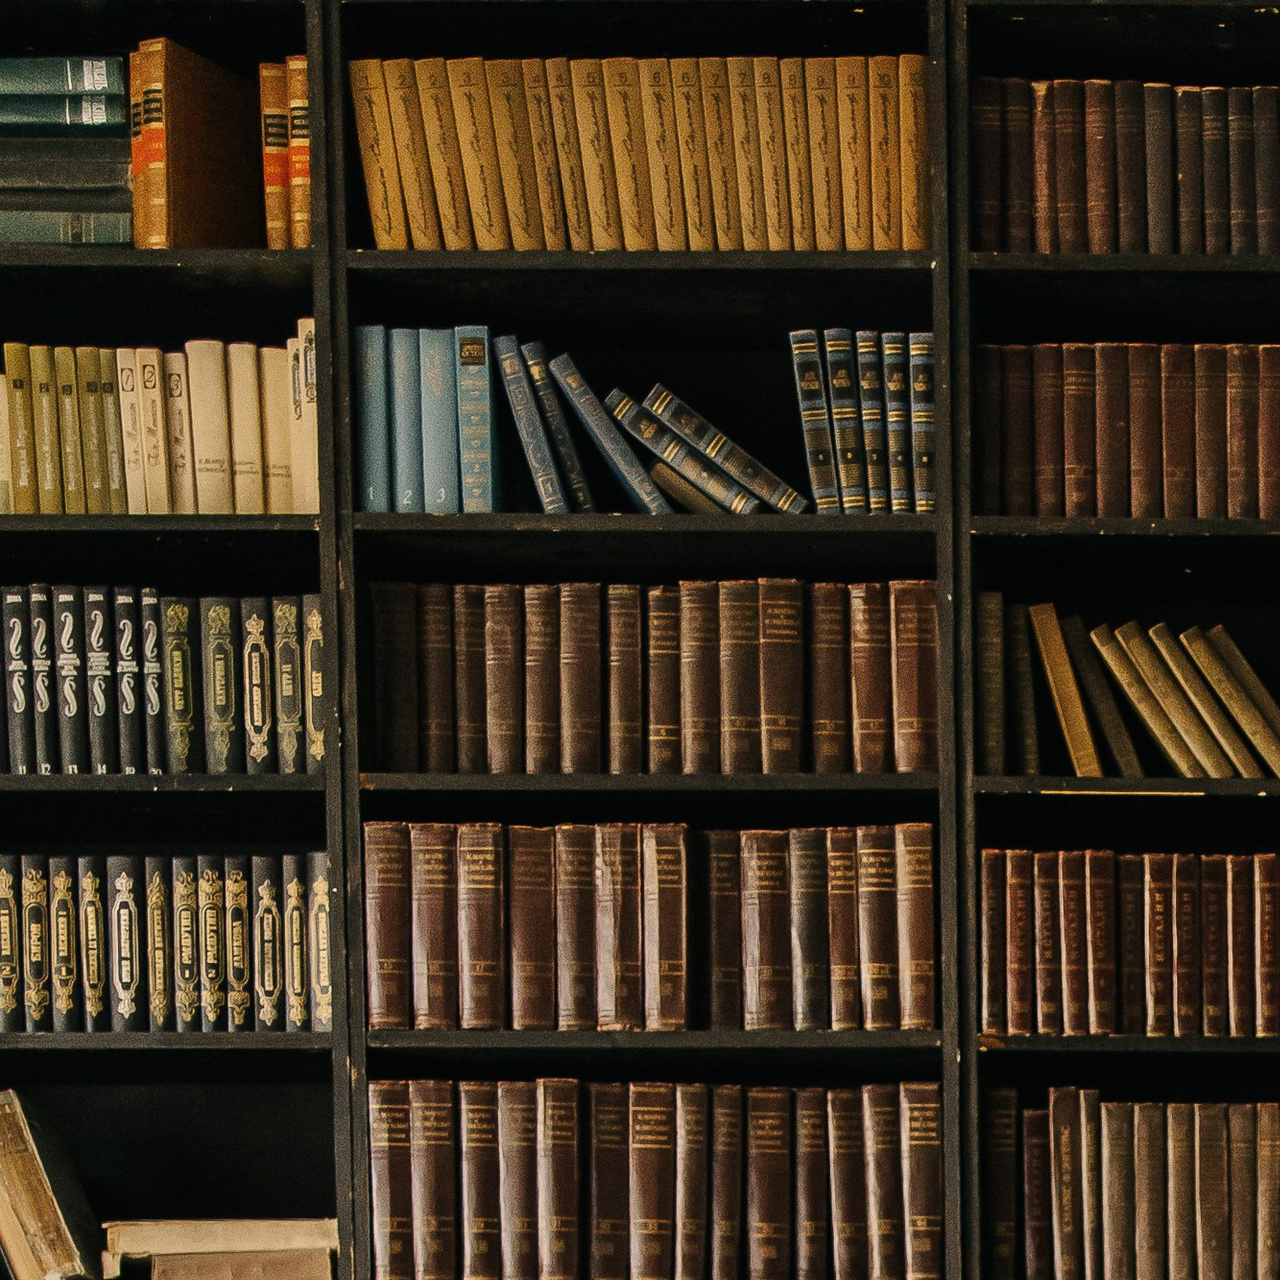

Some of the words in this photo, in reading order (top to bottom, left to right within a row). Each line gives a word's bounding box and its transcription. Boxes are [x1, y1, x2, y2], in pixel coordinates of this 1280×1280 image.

[403, 490, 412, 504] 2
[437, 488, 446, 502] 3
[180, 910, 193, 964] РАСПУТИН
[206, 908, 218, 964] РАСПУТИН
